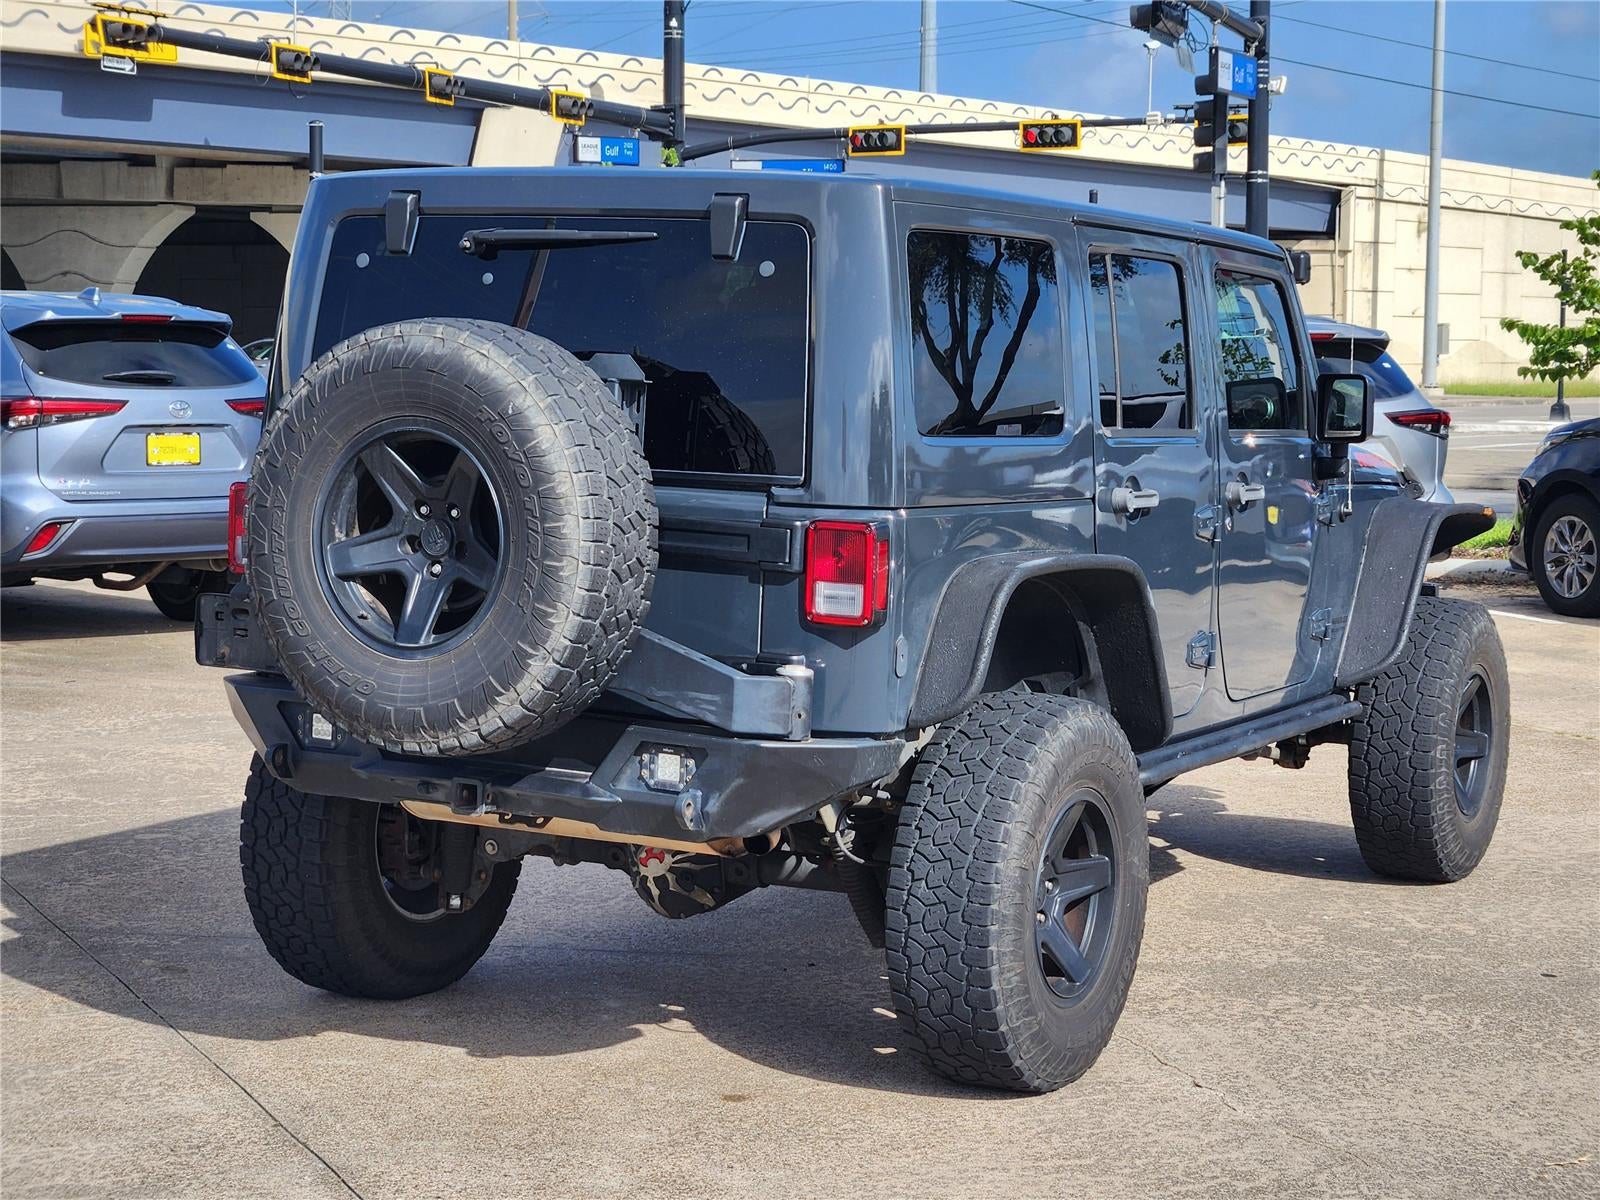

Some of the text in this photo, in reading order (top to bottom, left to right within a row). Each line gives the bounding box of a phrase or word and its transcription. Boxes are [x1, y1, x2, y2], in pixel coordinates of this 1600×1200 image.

[605, 145, 619, 157] Gulf
[476, 404, 533, 488] TOYO
[270, 484, 312, 638] COUNTRY
[305, 640, 378, 696] OPEN
